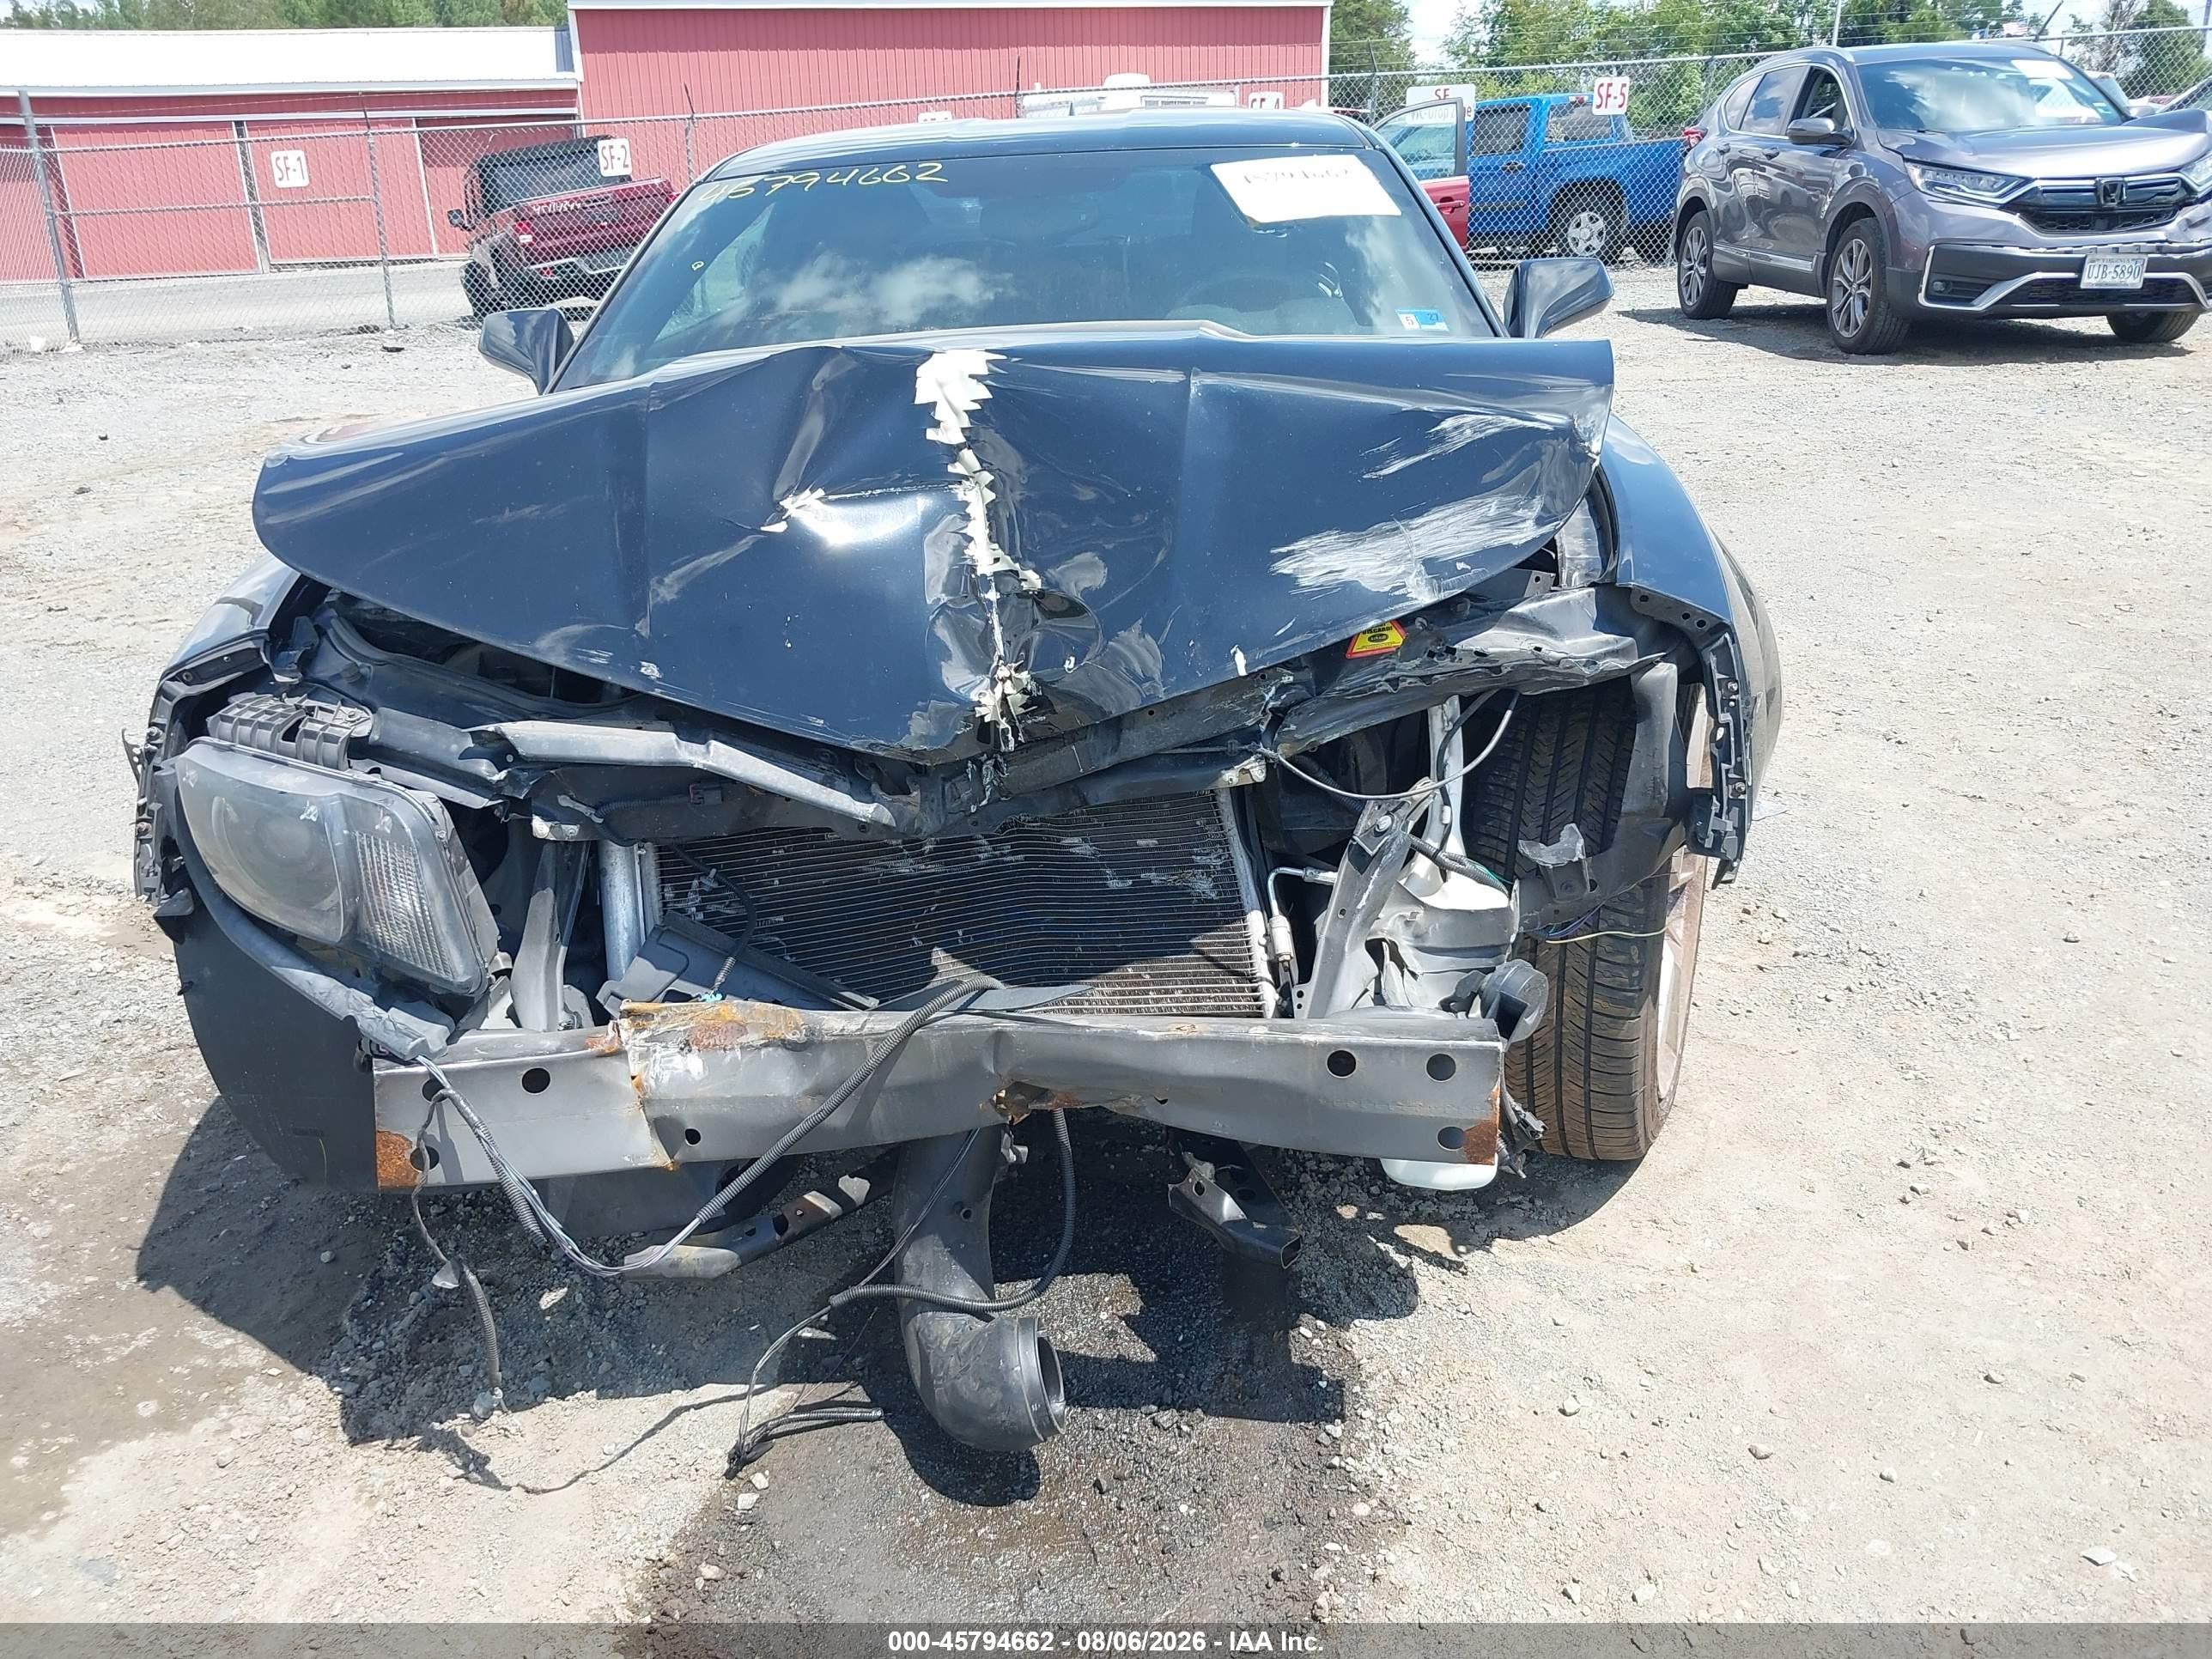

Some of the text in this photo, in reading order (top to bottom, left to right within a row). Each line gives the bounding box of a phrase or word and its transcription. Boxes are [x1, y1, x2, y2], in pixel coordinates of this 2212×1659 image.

[1595, 82, 1627, 109] SF-5
[275, 156, 306, 181] SF-1
[601, 144, 629, 170] SF-2
[698, 162, 949, 204] 45794662
[2087, 264, 2142, 280] UJB-5890
